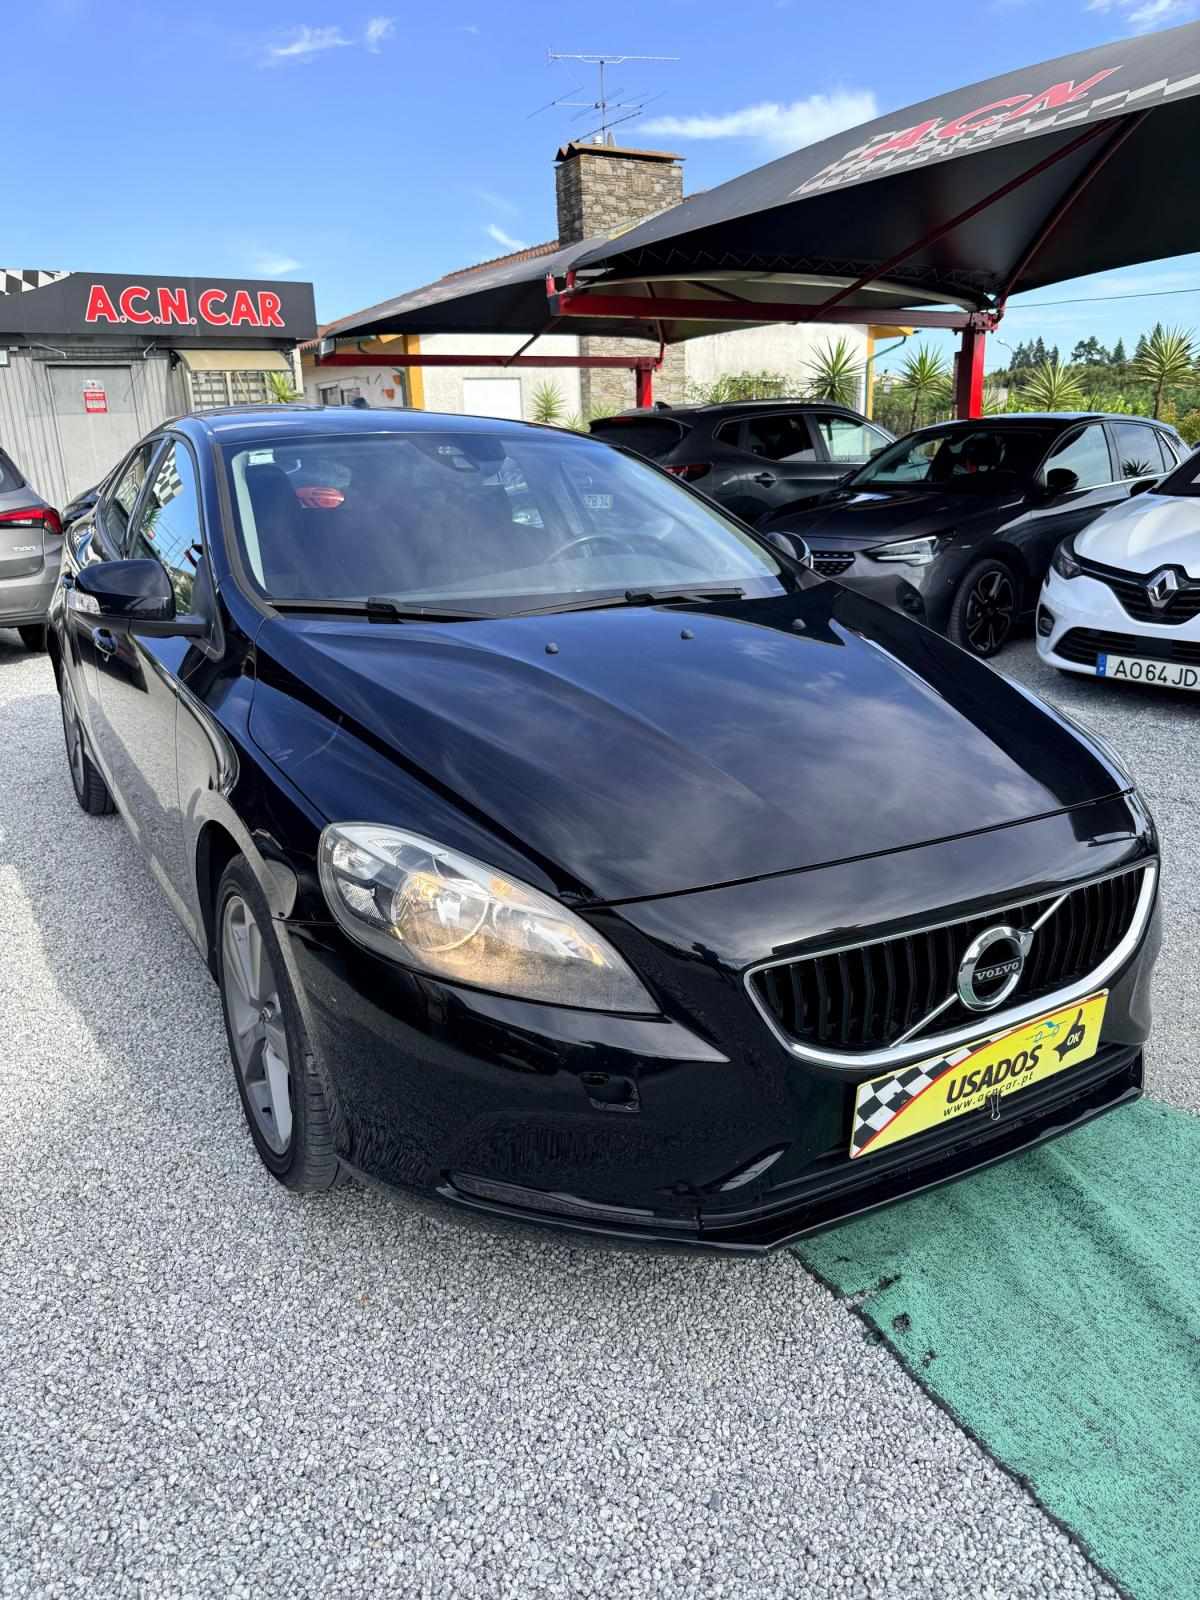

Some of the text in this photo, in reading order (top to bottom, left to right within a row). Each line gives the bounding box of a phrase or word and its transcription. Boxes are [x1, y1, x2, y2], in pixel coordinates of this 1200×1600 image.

[863, 64, 1124, 161] ACN
[84, 284, 286, 327] A.C.N. CAR
[975, 961, 1020, 981] VOLVO
[1066, 1032, 1082, 1046] OK
[945, 1044, 1043, 1104] USADOS
